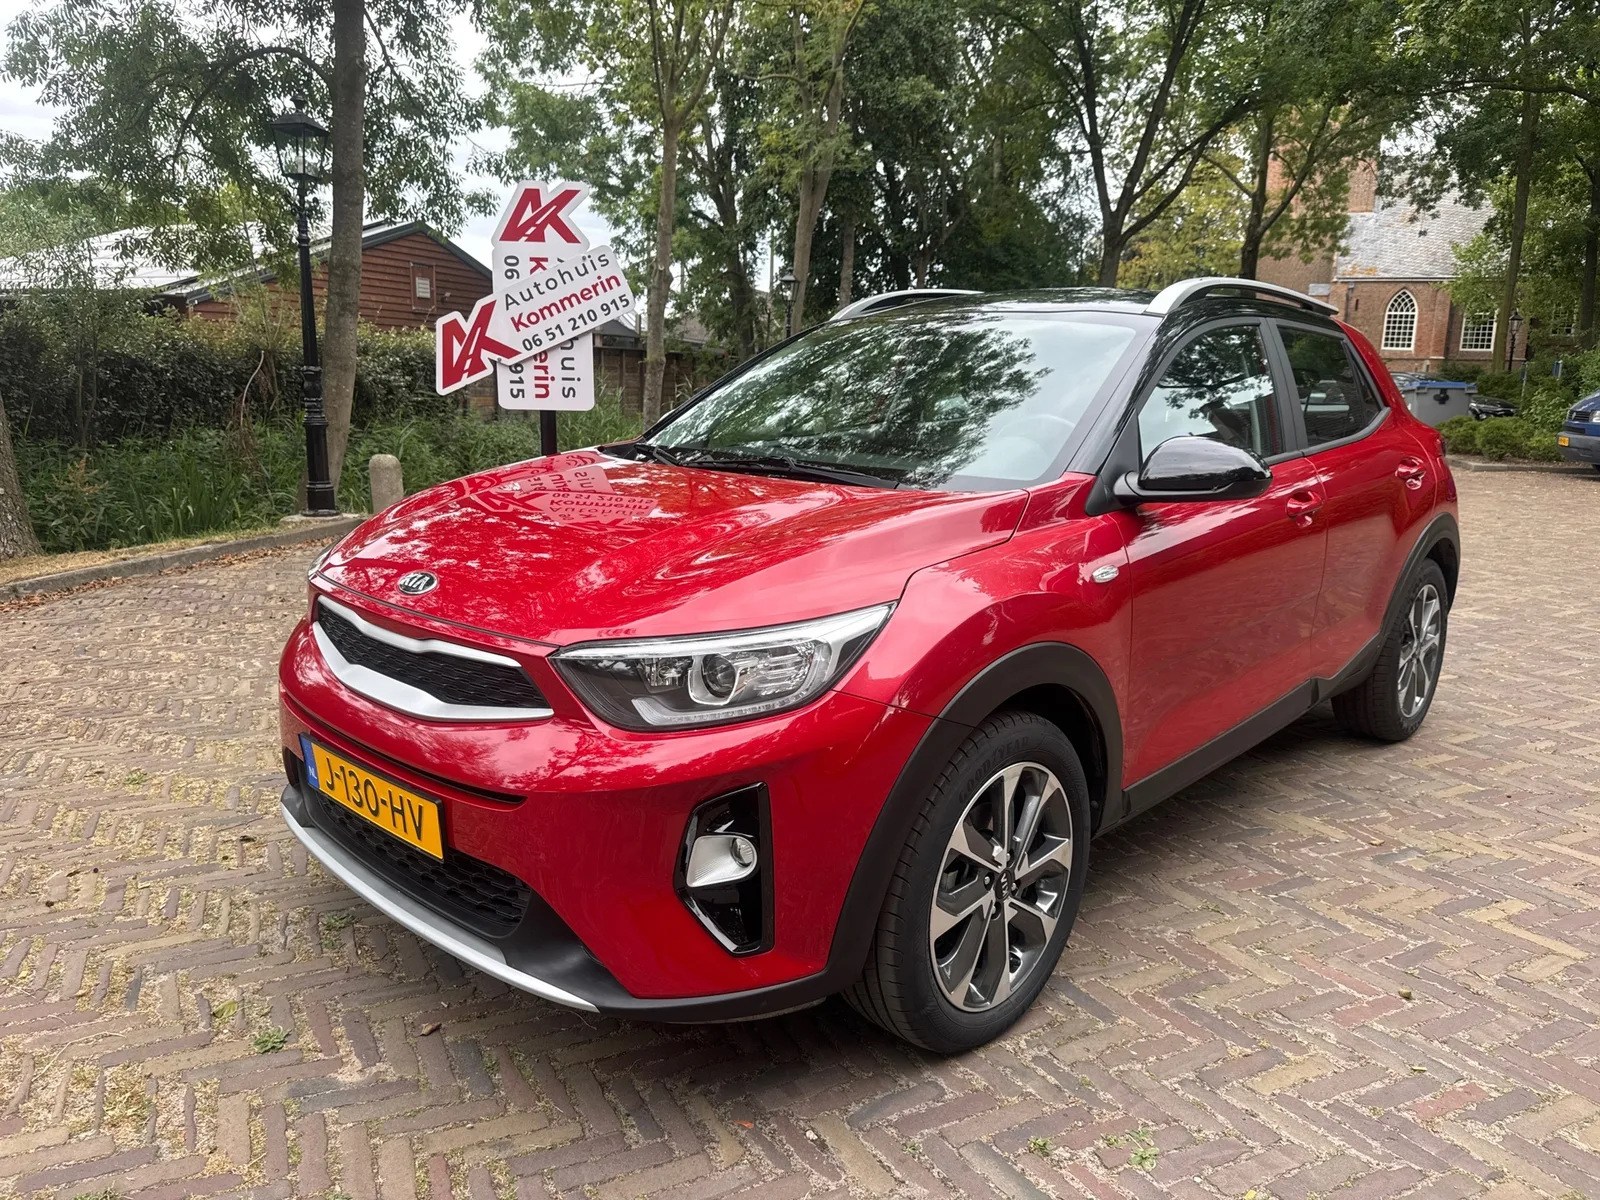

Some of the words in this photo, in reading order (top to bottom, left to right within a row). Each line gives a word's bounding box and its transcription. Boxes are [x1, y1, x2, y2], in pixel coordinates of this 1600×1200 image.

[504, 255, 520, 280] 06
[504, 253, 610, 311] Autohuis
[510, 275, 621, 333] Kommerin
[522, 333, 543, 352] 06
[545, 323, 565, 341] 51
[567, 308, 598, 332] 210
[600, 293, 630, 316] 915
[509, 363, 525, 399] 915
[308, 765, 318, 780] NL
[325, 757, 424, 842] J-130-HV
